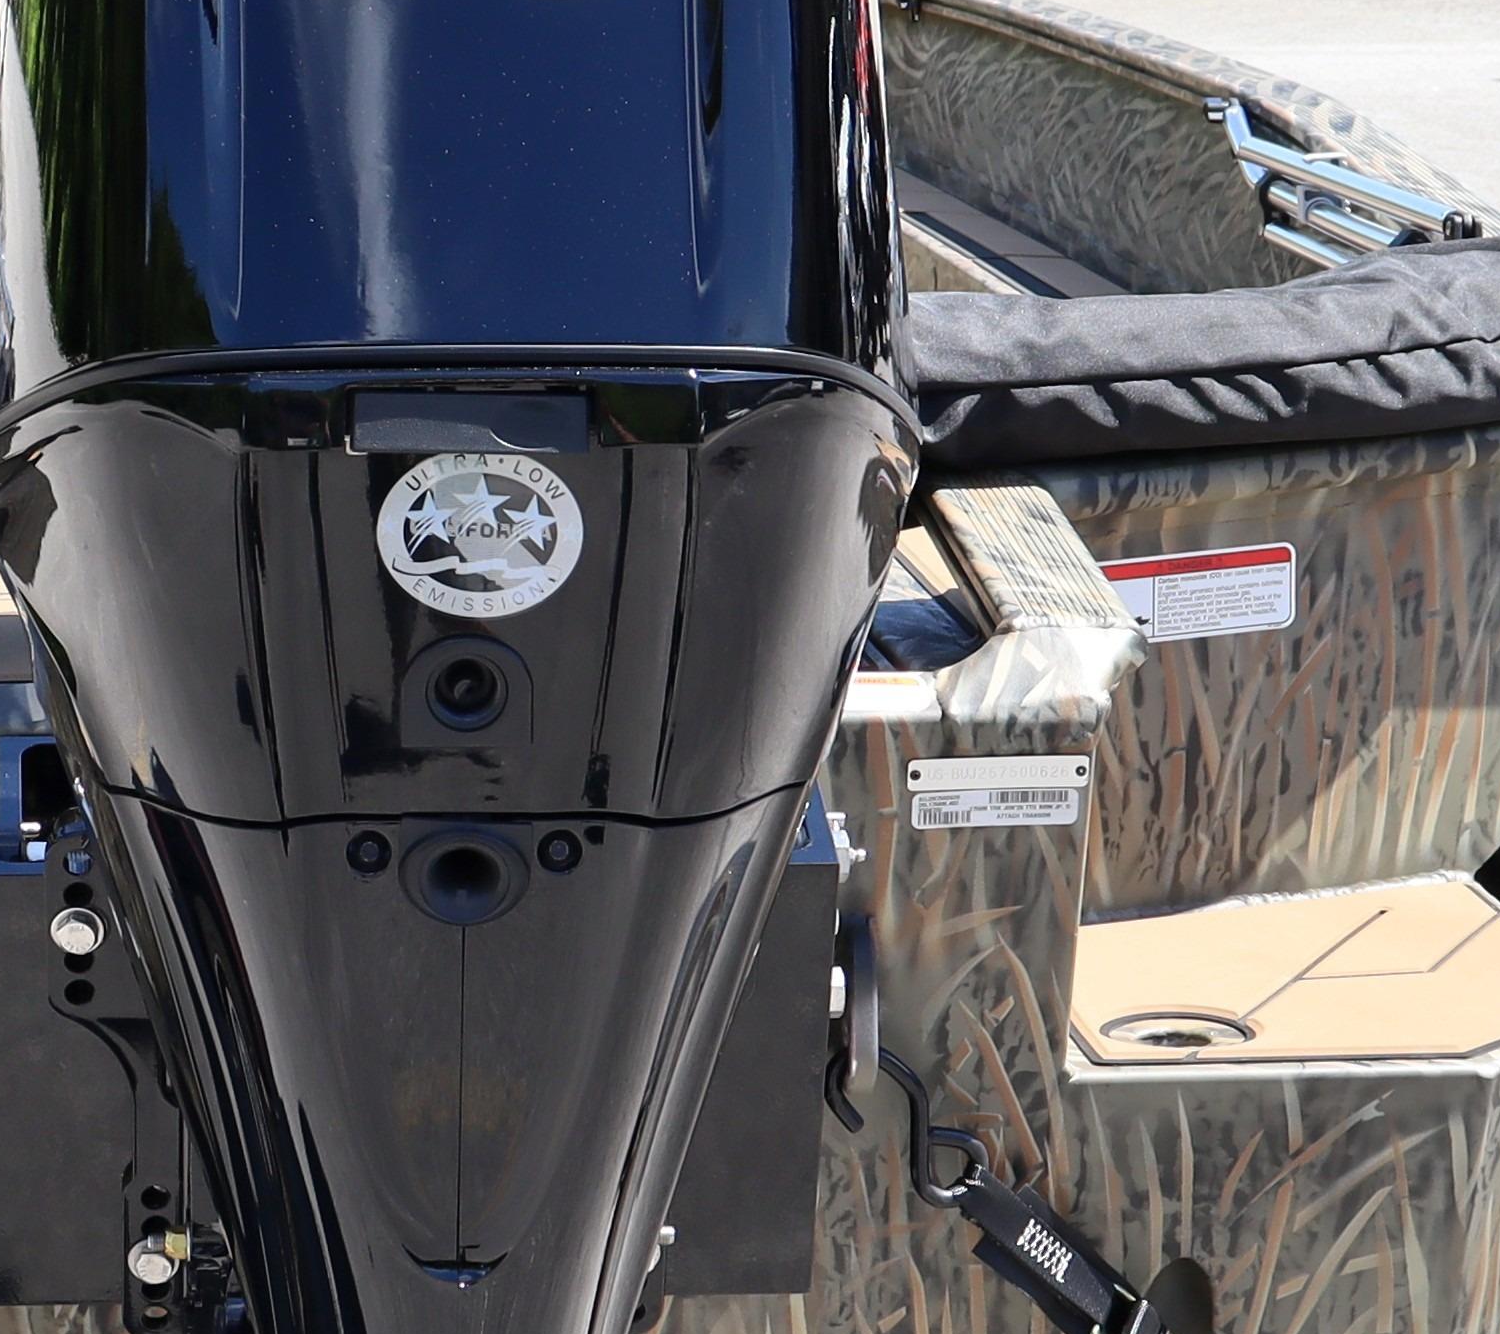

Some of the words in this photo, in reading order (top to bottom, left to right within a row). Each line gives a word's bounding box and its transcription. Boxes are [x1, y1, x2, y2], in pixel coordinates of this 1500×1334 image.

[405, 453, 489, 493] ULTRA
[512, 459, 566, 500] LOW
[412, 577, 545, 612] EMISSION
